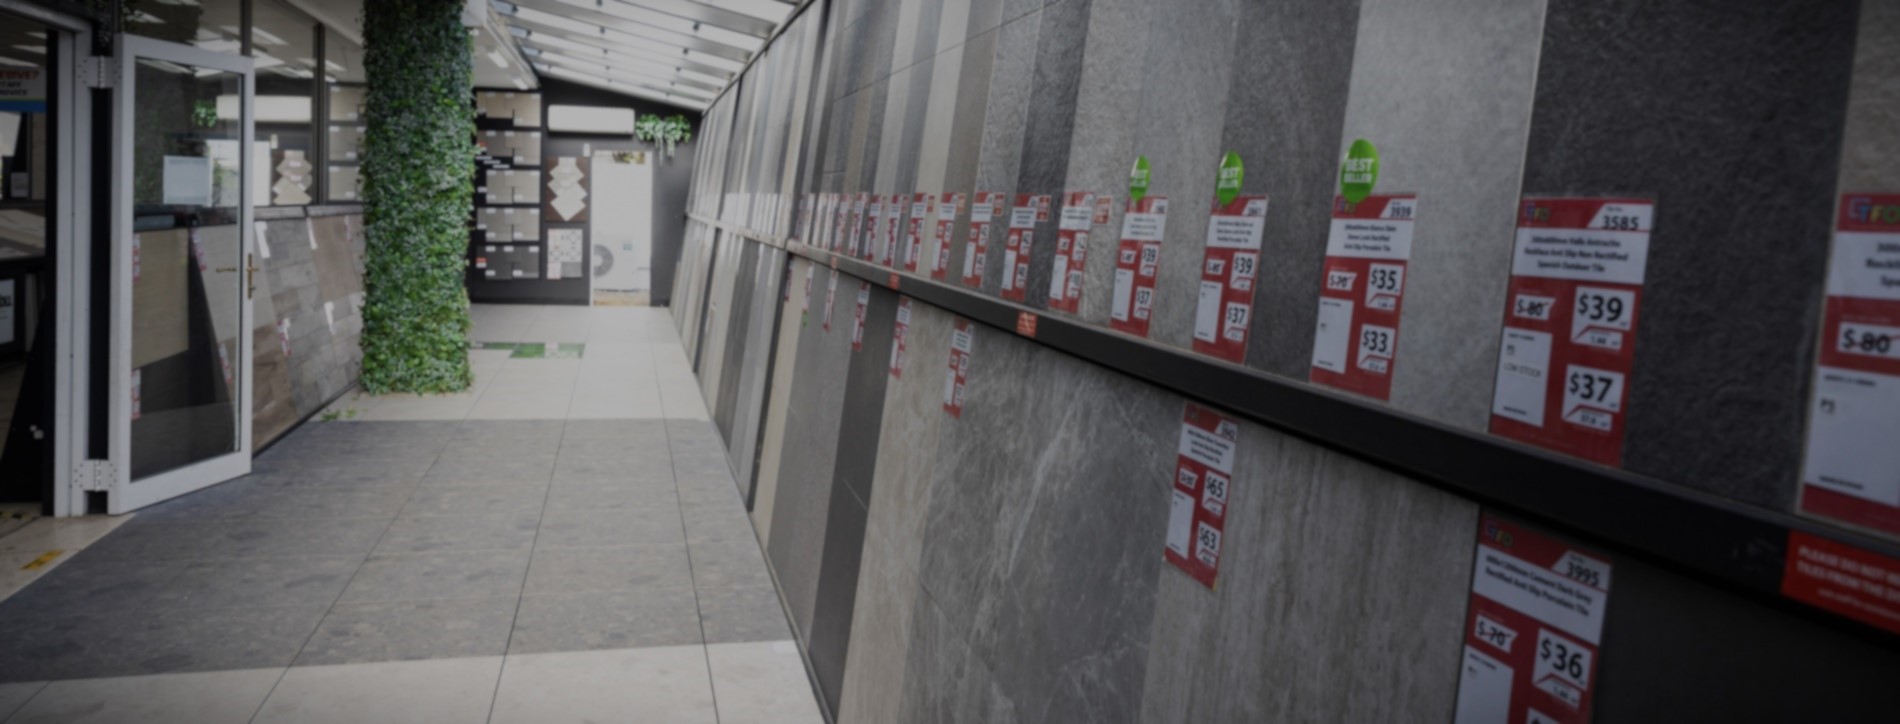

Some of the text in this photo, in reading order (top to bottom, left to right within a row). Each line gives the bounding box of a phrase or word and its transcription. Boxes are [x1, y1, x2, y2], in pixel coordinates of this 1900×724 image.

[1345, 158, 1374, 172] BEST
[1602, 215, 1639, 230] 3585
[1234, 257, 1253, 274] $39
[1371, 268, 1397, 290] $35
[1228, 307, 1245, 325] $37
[1578, 292, 1623, 322] $39
[1363, 329, 1388, 352] $33
[1570, 372, 1613, 402] $37
[1567, 561, 1599, 586] 3995
[1541, 638, 1583, 679] $36
